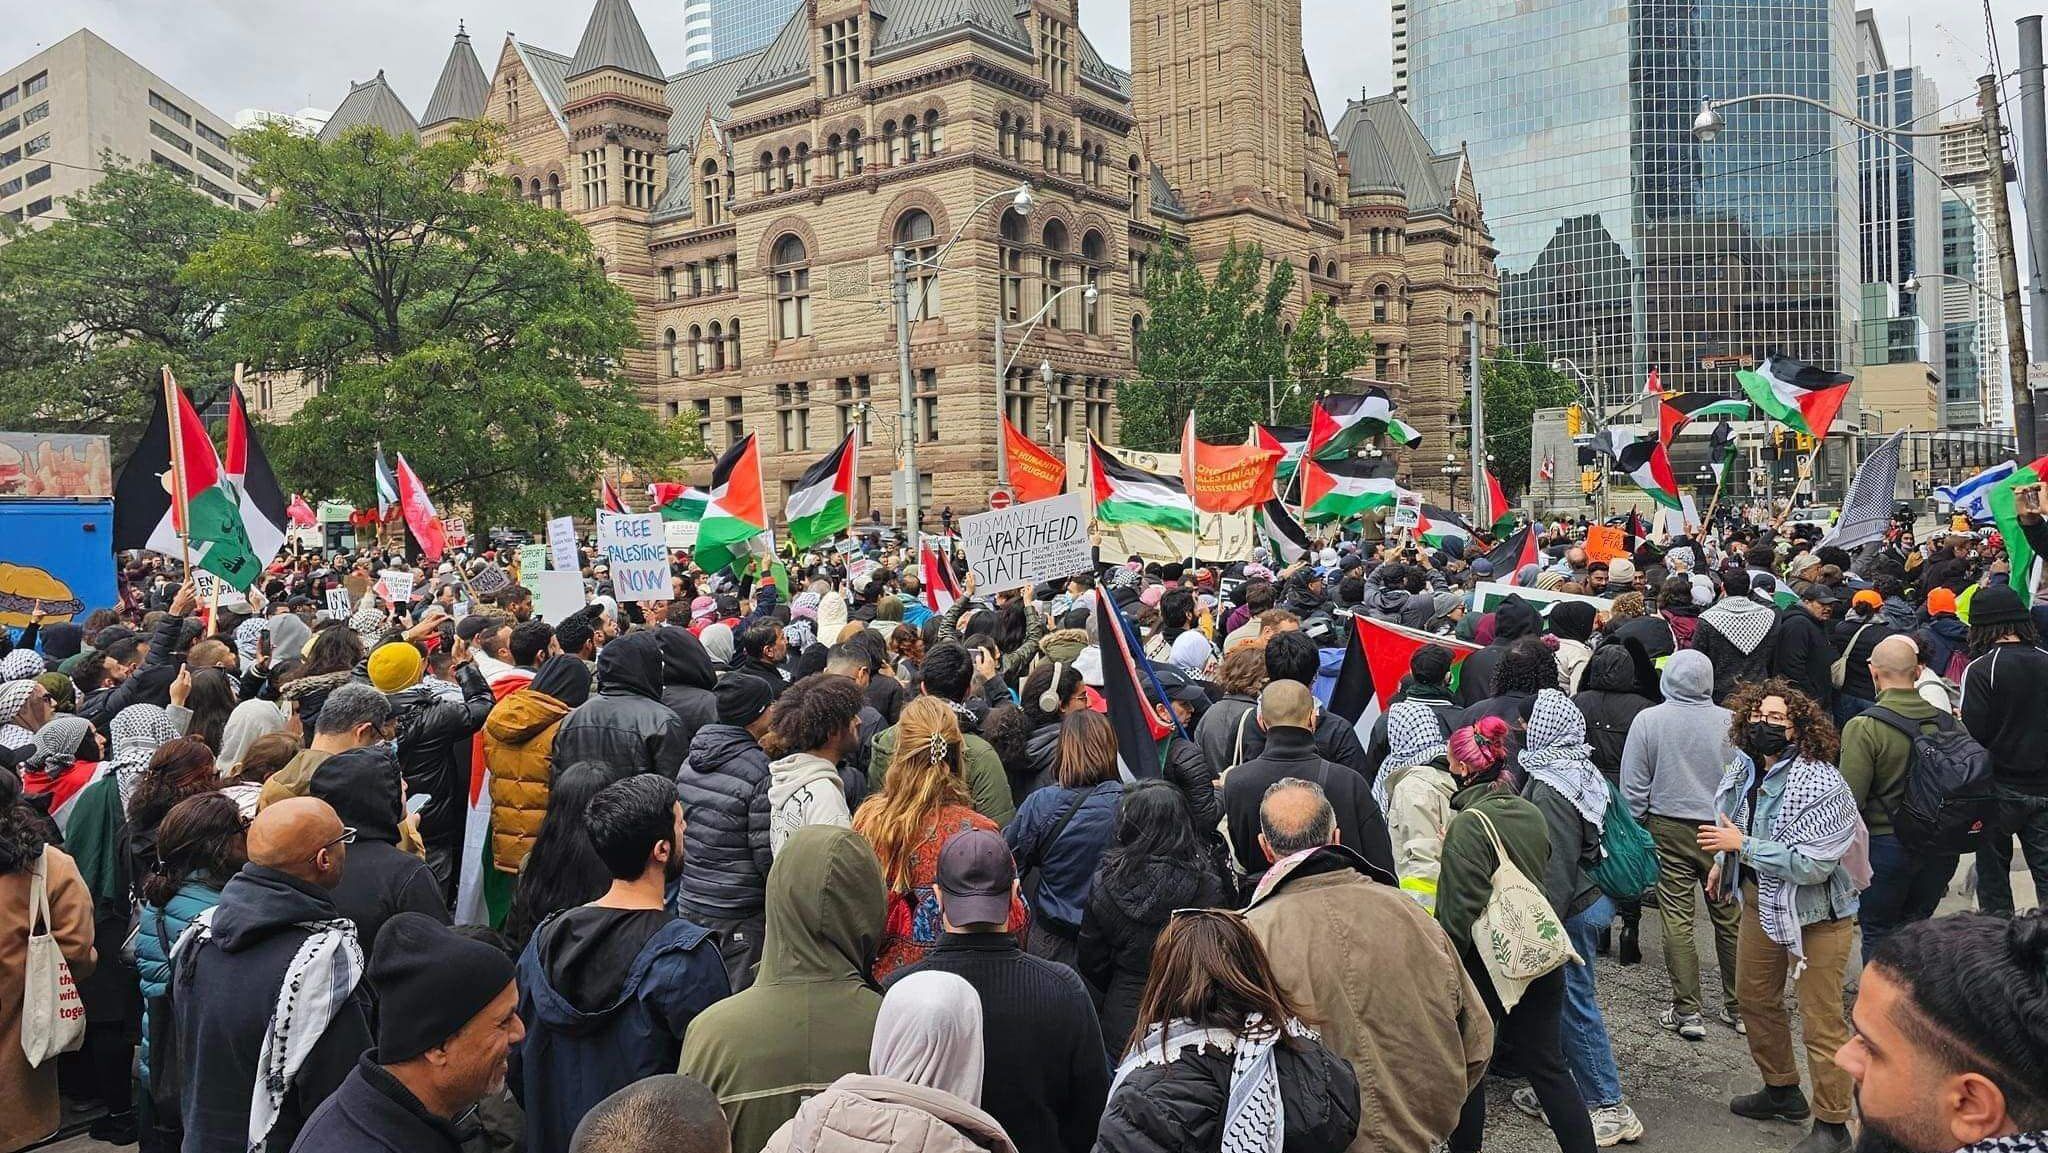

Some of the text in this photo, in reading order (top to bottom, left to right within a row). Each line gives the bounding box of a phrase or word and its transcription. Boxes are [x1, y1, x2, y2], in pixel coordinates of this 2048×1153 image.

[1018, 462, 1055, 482] TRUGGLE
[1196, 463, 1220, 475] ONG
[1249, 452, 1271, 464] THE
[1195, 467, 1260, 483] ALESTINIAN
[615, 519, 652, 538] FREE
[968, 504, 1053, 537] DISMANTLE
[983, 515, 1078, 560] APARTHEID
[608, 543, 666, 563] PALESTINE
[973, 549, 1033, 588] STATE
[197, 575, 215, 587] EN
[619, 566, 665, 594] NOW
[59, 1006, 86, 1021] toge
